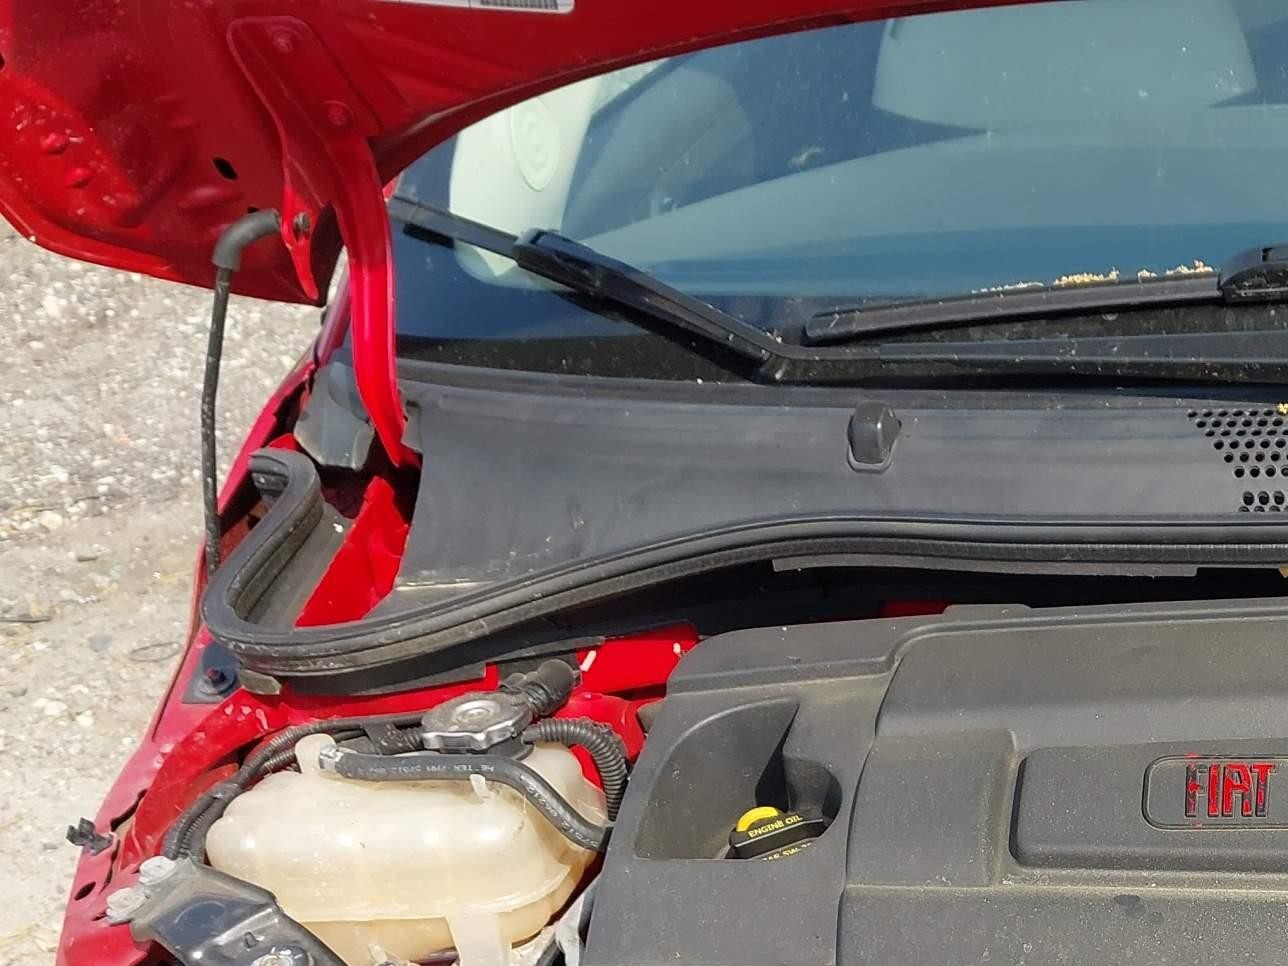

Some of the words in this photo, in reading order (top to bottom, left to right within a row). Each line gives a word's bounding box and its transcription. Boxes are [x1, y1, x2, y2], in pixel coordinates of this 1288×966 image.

[1184, 764, 1276, 818] FIAT
[748, 820, 784, 838] ENGINE
[785, 814, 803, 825] OIL
